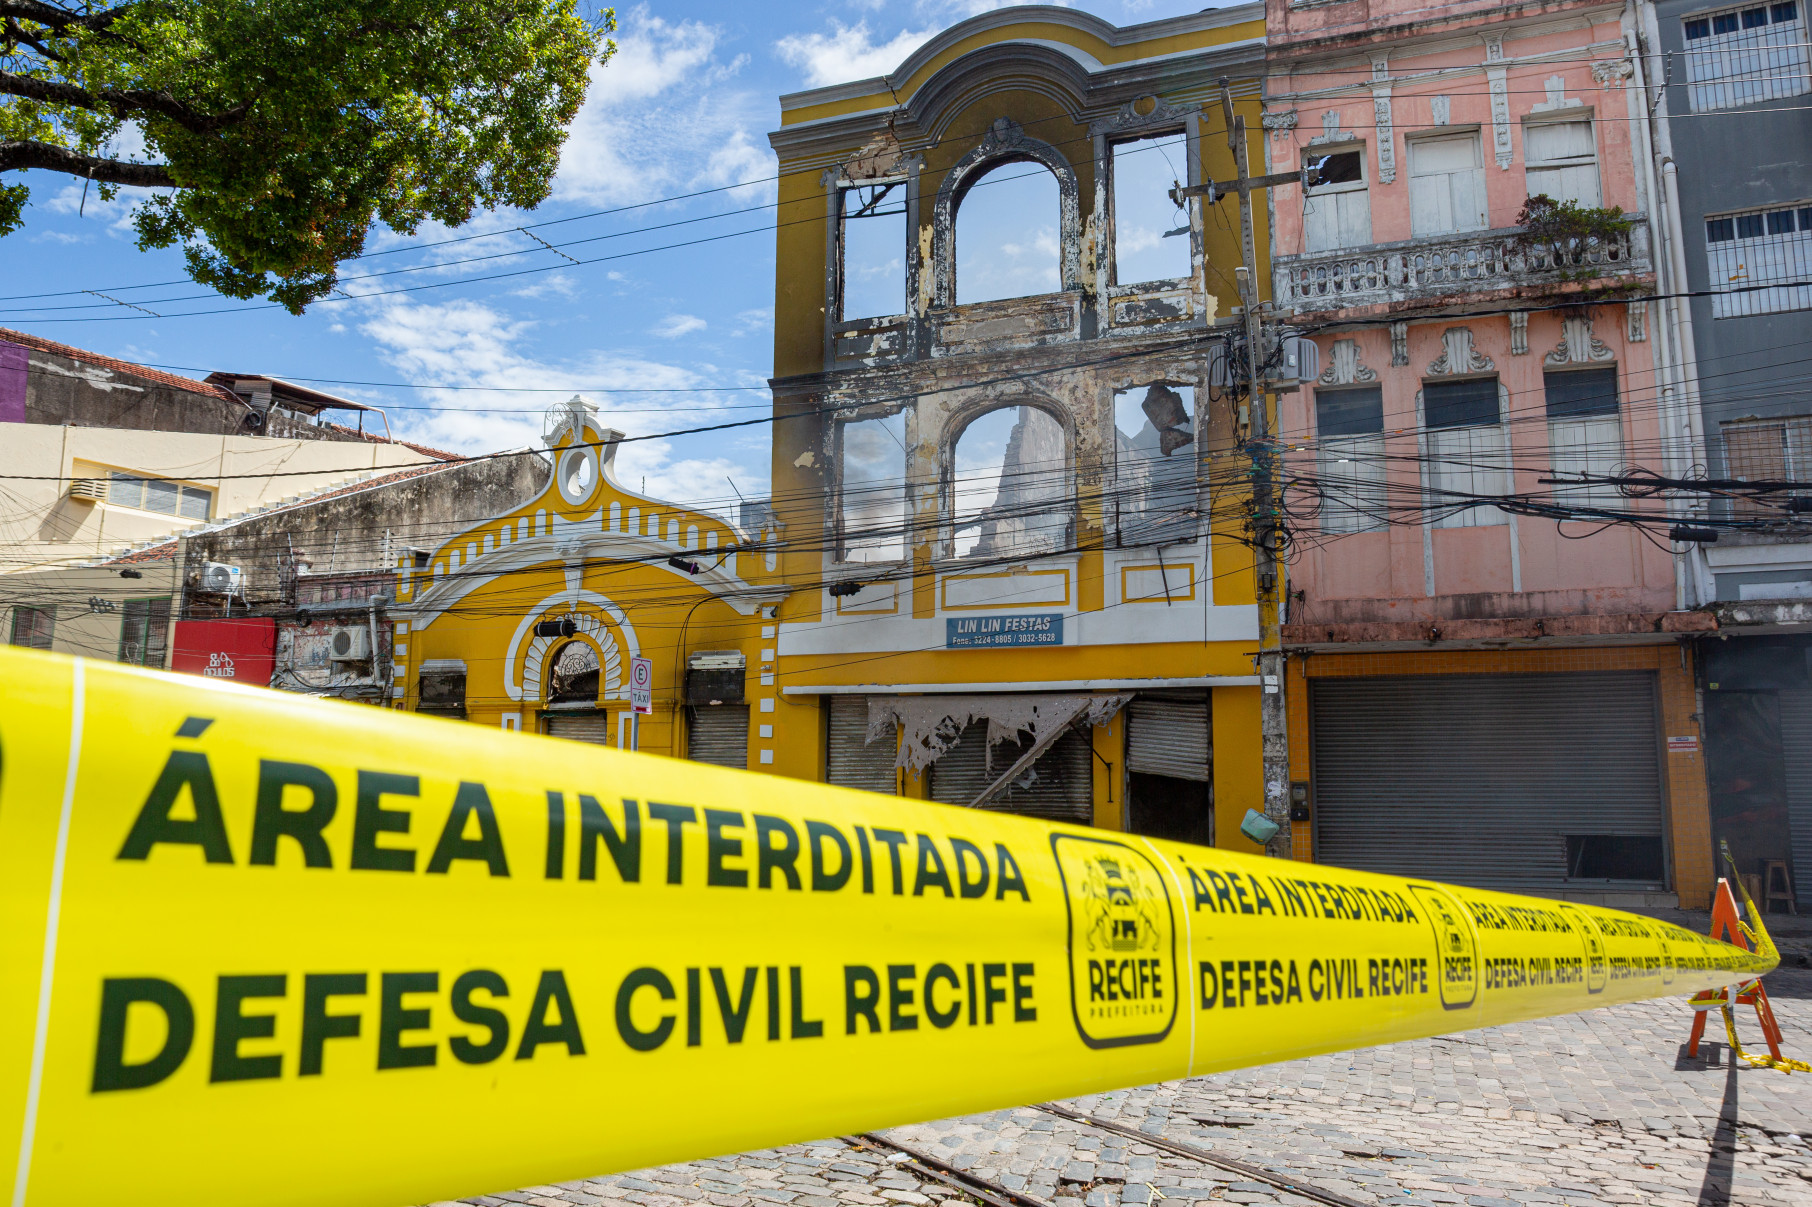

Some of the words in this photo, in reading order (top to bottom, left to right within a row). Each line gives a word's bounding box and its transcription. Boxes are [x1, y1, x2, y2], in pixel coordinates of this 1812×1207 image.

[957, 620, 977, 633] LIN
[980, 618, 1001, 633] LIN
[1005, 617, 1051, 631] FESTAS
[1018, 633, 1056, 643] 3032-5628
[638, 668, 643, 680] E
[633, 691, 649, 702] TÁXI
[114, 716, 512, 879] ÁREA
[544, 790, 1032, 903] INTERDITADA
[1177, 854, 1278, 916] ÁREA
[1267, 875, 1420, 925] INTERDITADA
[1087, 959, 1163, 1002] RECIFE
[1198, 958, 1304, 1010] DEFESA
[1308, 958, 1364, 1002] CIVIL
[1367, 957, 1429, 999] RECIFE
[1484, 957, 1527, 990] DEFESA
[1089, 1003, 1165, 1019] PREFEITURA
[89, 968, 587, 1095] DEFESA
[614, 965, 824, 1052] CIVIL
[842, 962, 1038, 1036] RECIFE
